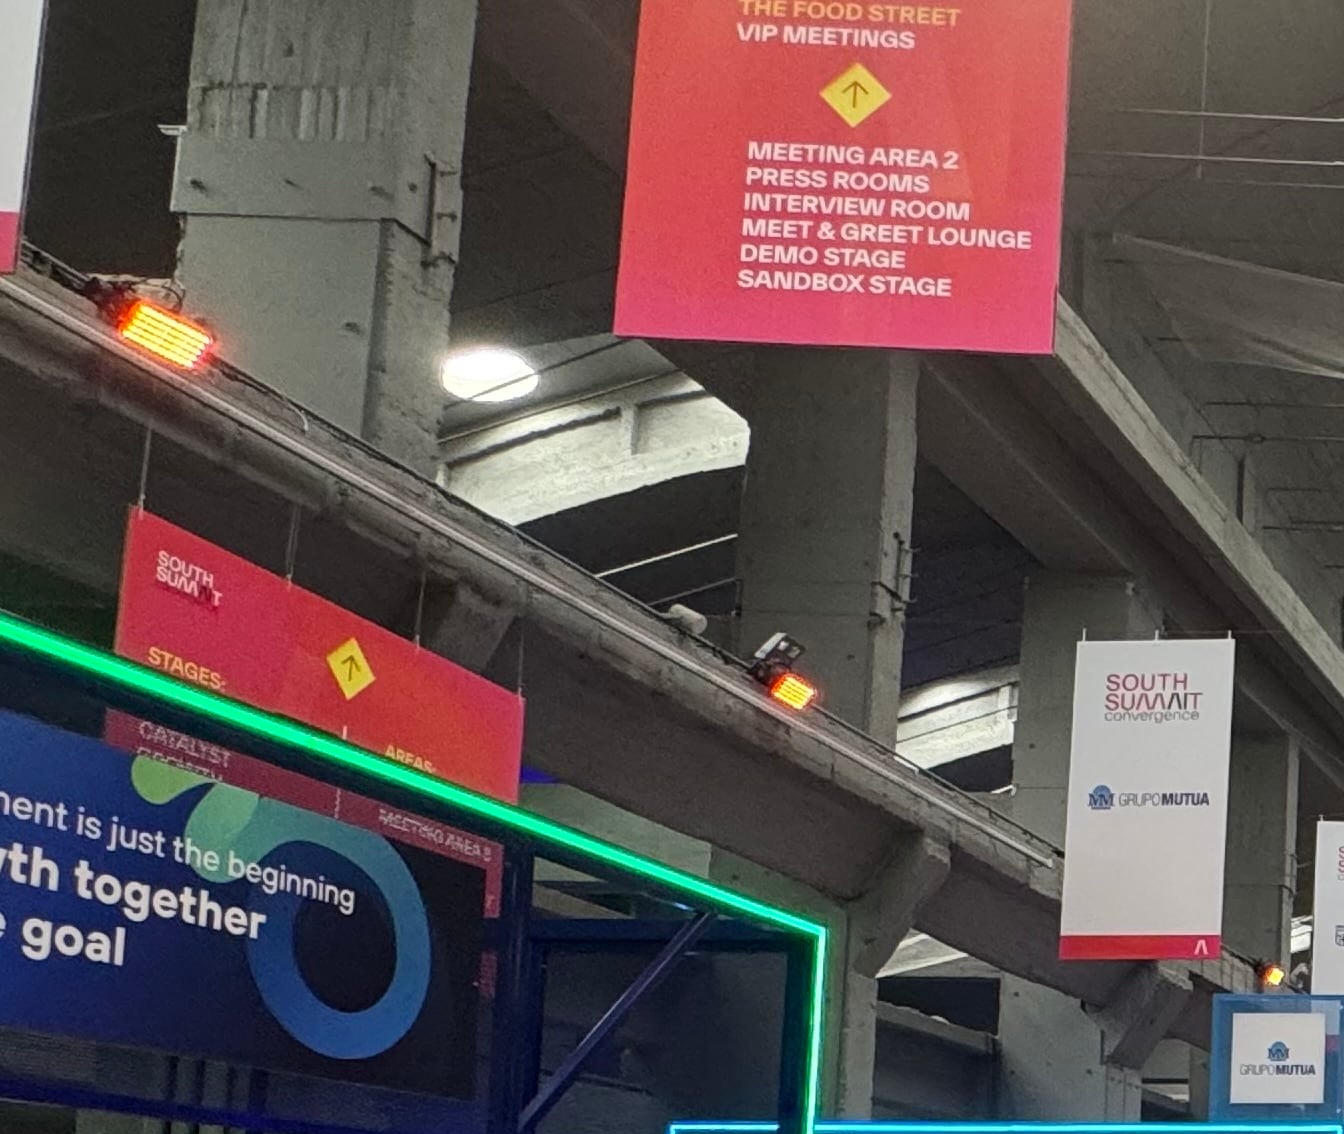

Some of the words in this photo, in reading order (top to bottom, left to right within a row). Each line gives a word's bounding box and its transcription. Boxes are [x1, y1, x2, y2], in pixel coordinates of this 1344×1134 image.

[739, 0, 787, 17] THE
[793, 2, 864, 21] FOOD
[868, 5, 961, 26] STREET
[737, 23, 777, 42] VIP
[783, 25, 915, 49] MEETINGS
[748, 141, 865, 164] MEETING
[870, 147, 937, 168] AREA
[943, 151, 959, 169] 2
[745, 168, 827, 188] PRESS
[833, 172, 930, 193] ROOMS
[744, 193, 885, 217] INTERVIEW
[892, 199, 970, 221] ROOM
[742, 218, 809, 240] MEET
[817, 221, 834, 241] &
[841, 223, 923, 245] GREET
[928, 227, 1032, 249] LOUNGE
[740, 244, 818, 266] DEMO
[823, 247, 905, 269] STAGE
[737, 270, 865, 294] SANDBOX
[869, 276, 952, 297] STAGE
[158, 550, 214, 588] SOUTH
[148, 646, 226, 692] STAGES:
[1106, 673, 1188, 692] SOUTH
[1104, 692, 1203, 712] SUMMIT
[1104, 709, 1200, 724] convergence
[76, 805, 102, 841] is
[106, 815, 165, 859] just
[173, 834, 219, 873] the
[227, 851, 356, 917] beginning
[0, 842, 60, 892] th
[74, 859, 268, 940] together
[21, 916, 126, 967] goal
